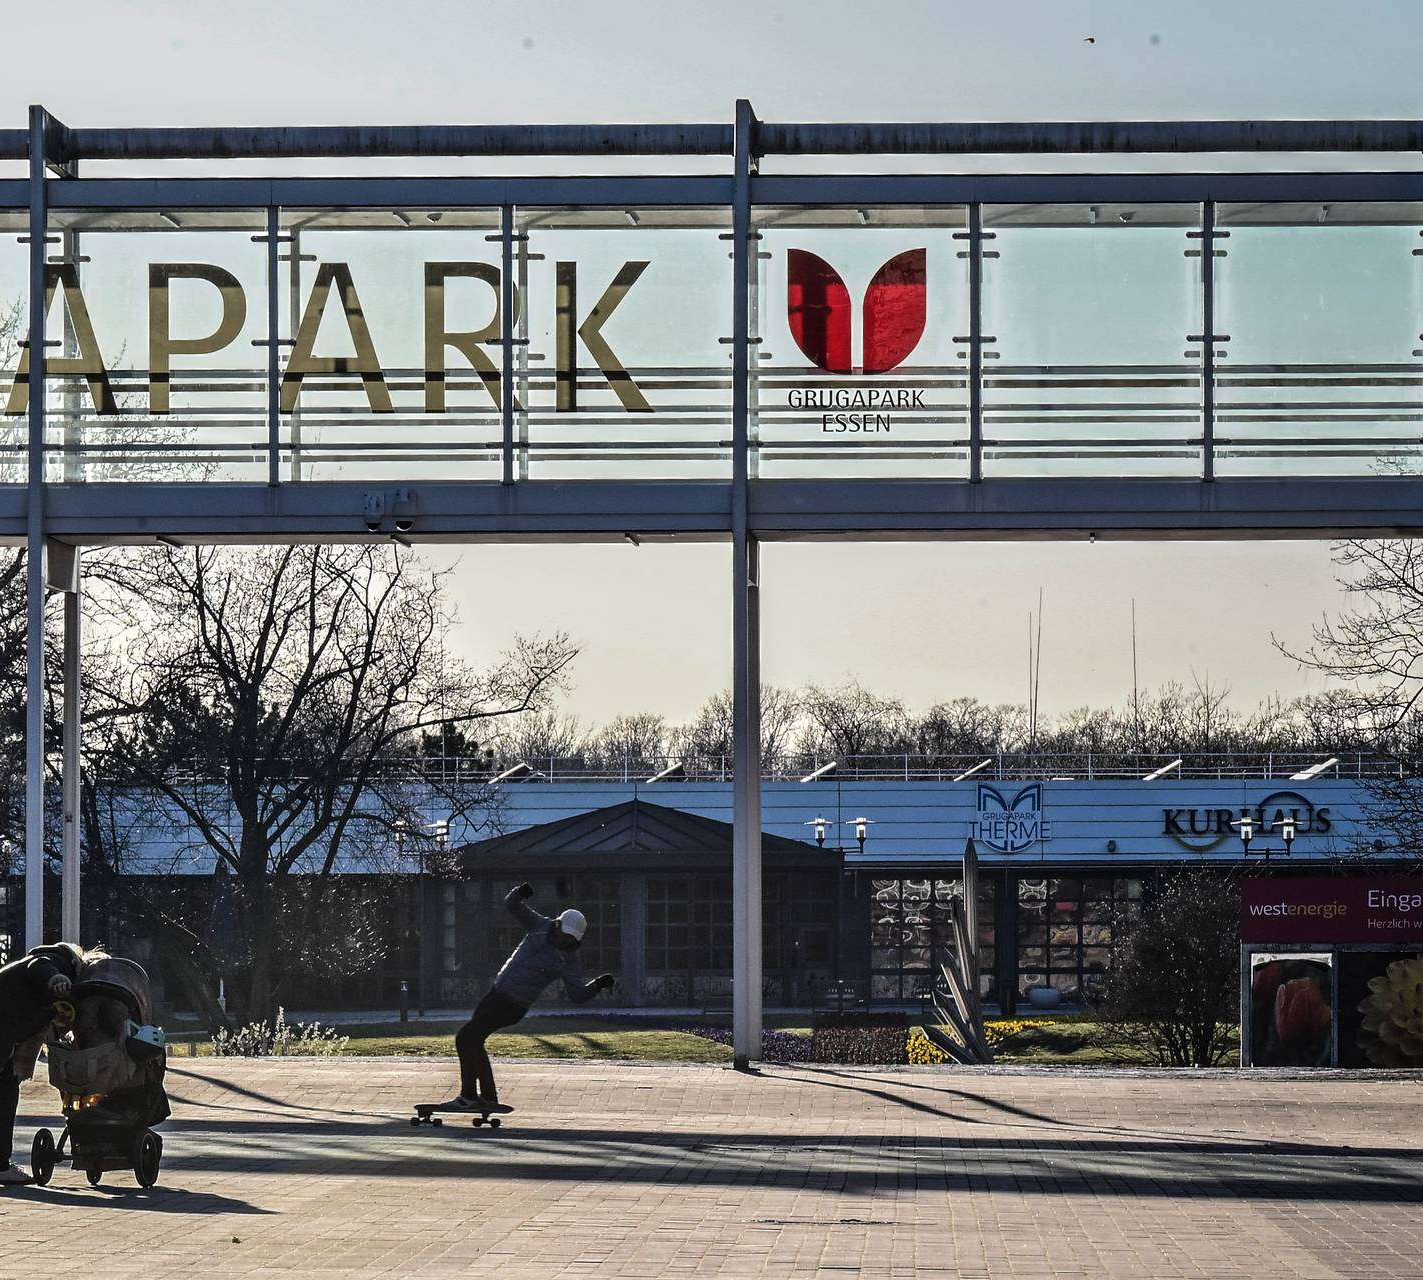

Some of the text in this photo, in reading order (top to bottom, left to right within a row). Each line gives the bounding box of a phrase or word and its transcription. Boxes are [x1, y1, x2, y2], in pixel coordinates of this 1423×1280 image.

[787, 389, 926, 408] GRUGAPARK
[822, 414, 891, 433] ESSEN
[982, 812, 1037, 821] GRUGAPARK
[1161, 807, 1332, 835] KURHAUS
[968, 821, 1051, 839] THERME
[1249, 900, 1347, 919] westenergie
[1368, 889, 1422, 912] Einga
[1368, 918, 1410, 929] Herzlich
